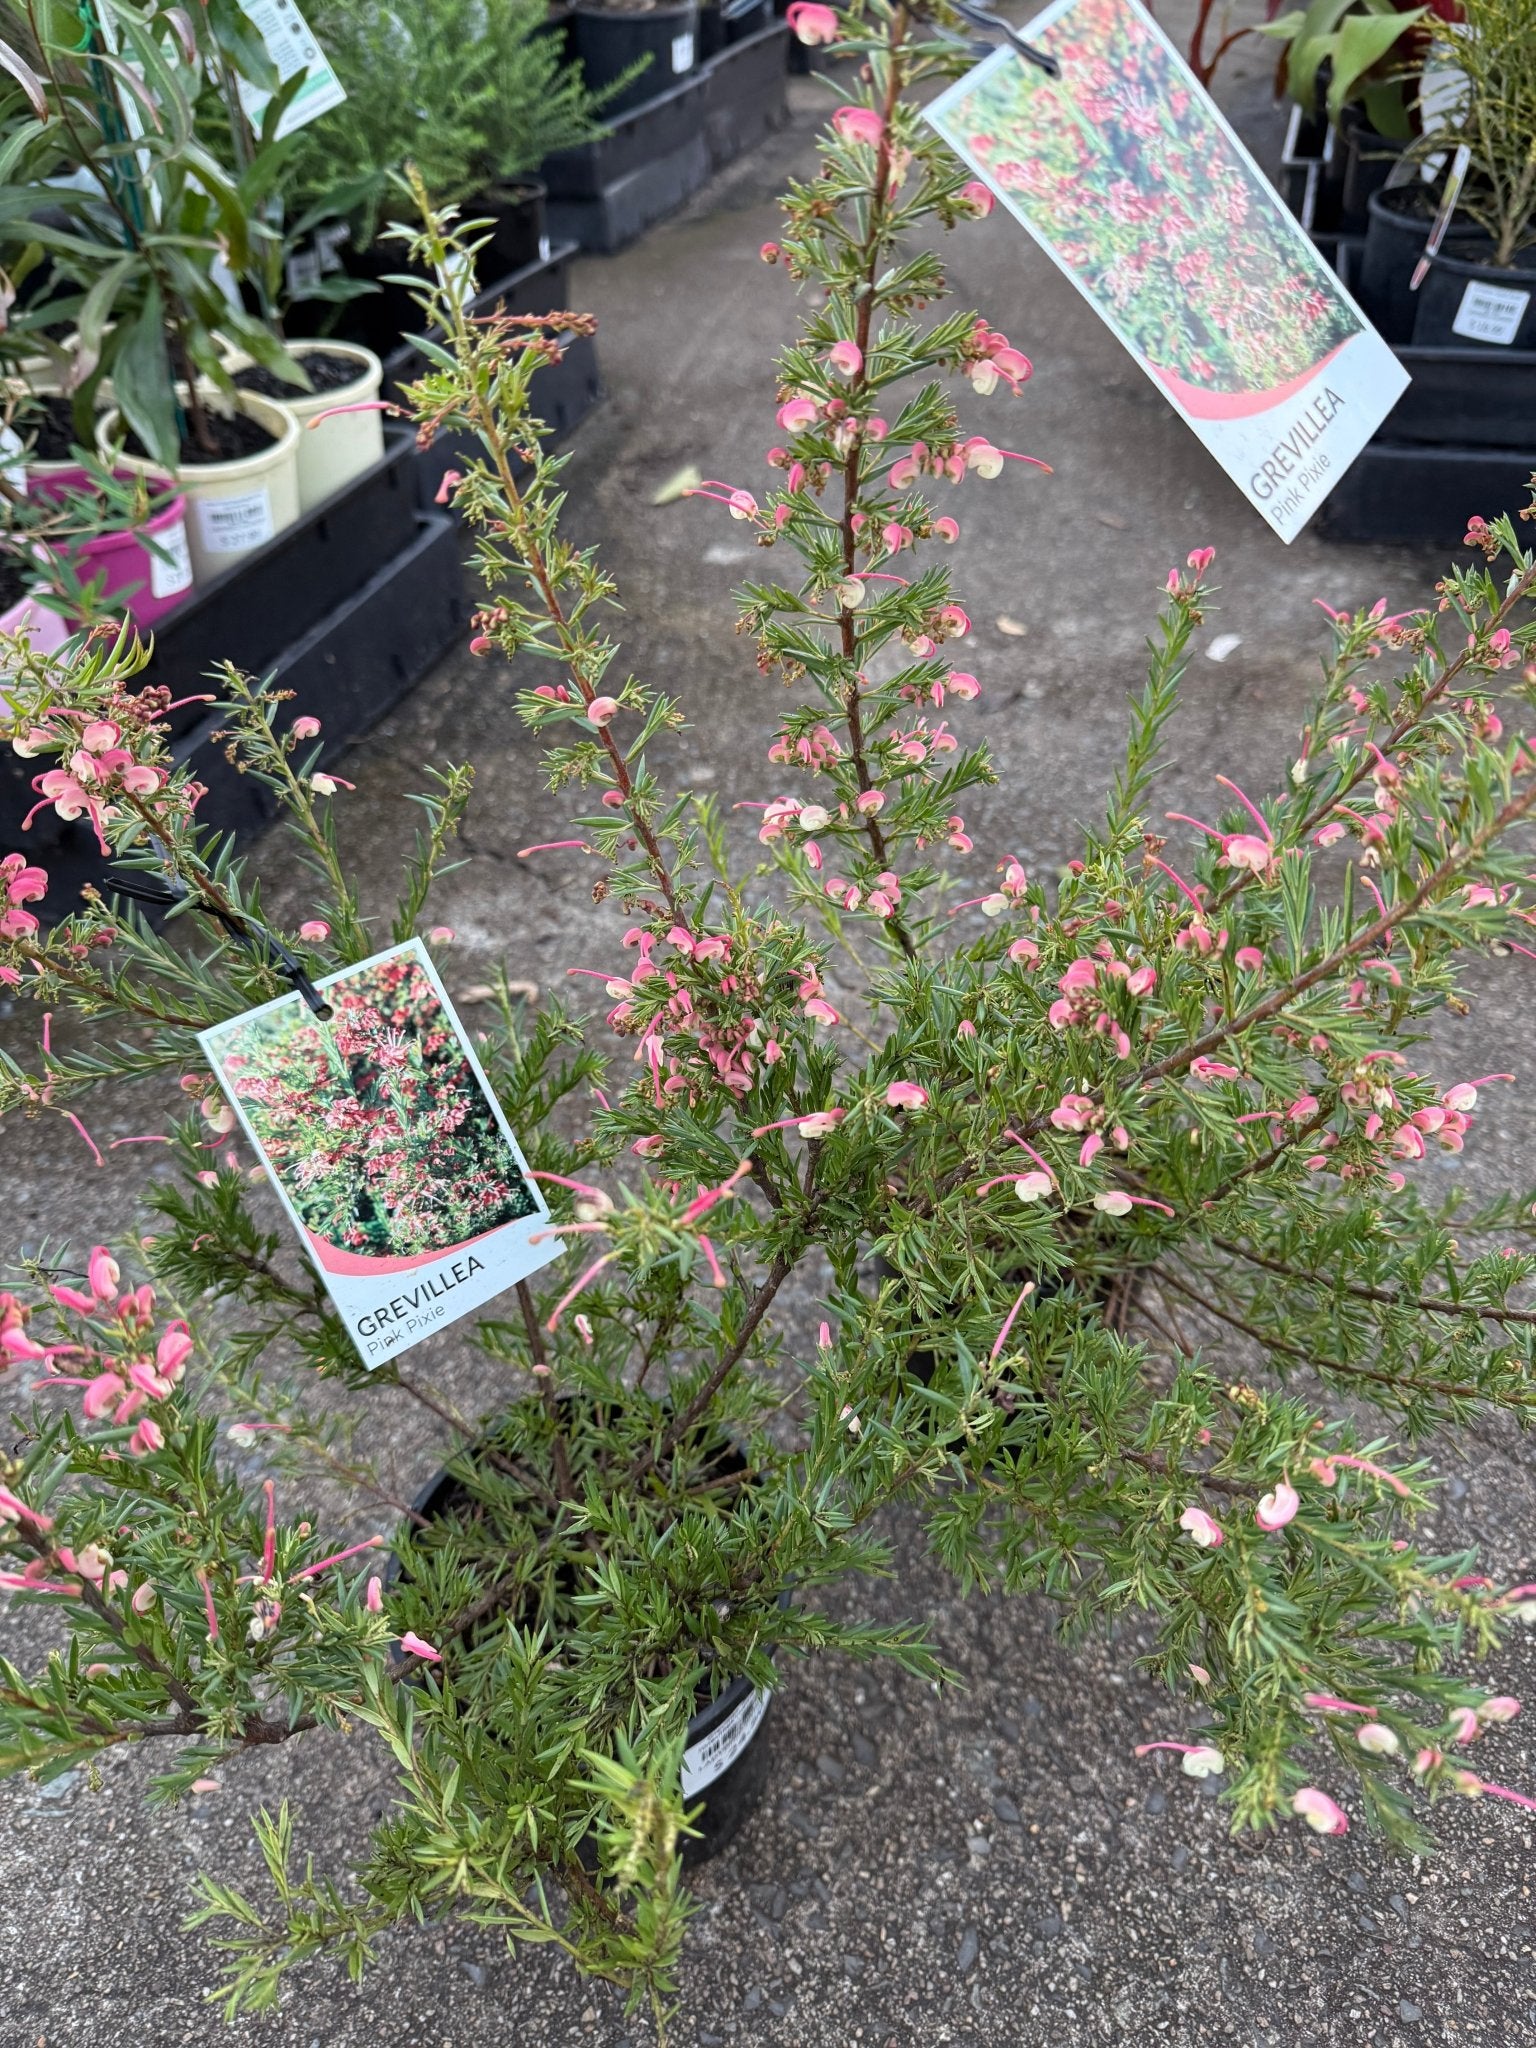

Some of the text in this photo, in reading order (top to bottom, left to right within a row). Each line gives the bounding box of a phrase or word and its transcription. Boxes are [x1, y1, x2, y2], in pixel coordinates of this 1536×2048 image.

[1251, 387, 1345, 500] GREVILLEA
[1270, 454, 1331, 526] Pink Pixie
[357, 1255, 485, 1337] GREVILLEA
[366, 1304, 446, 1356] Pink Pixie
